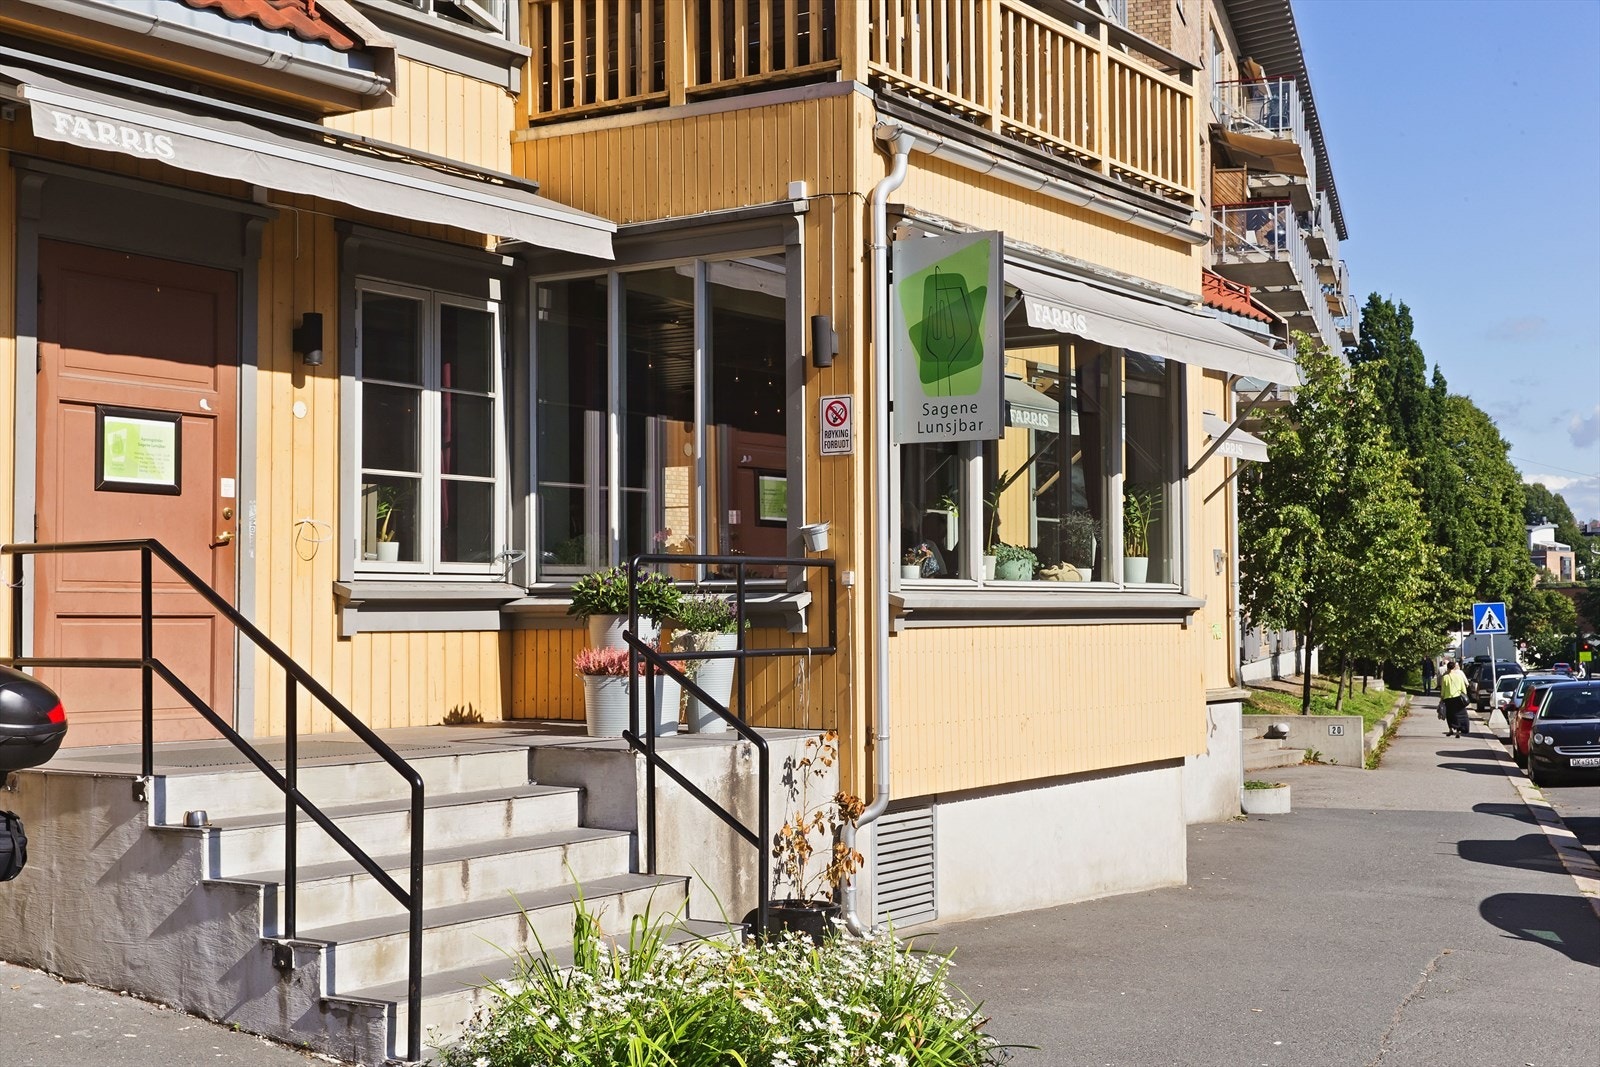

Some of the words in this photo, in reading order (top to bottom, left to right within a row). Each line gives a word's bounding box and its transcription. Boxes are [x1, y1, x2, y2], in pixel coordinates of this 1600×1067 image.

[51, 110, 176, 160] FARRIS
[1032, 303, 1088, 334] FARRIS
[921, 402, 978, 419] Sagene
[1009, 408, 1049, 427] FARRIS
[824, 428, 849, 439] RØYKING
[917, 418, 984, 436] Lunsjbar
[824, 439, 849, 450] FORBUDT
[1216, 441, 1243, 456] ARRIS
[1331, 726, 1342, 735] 20
[1584, 757, 1600, 766] 915
